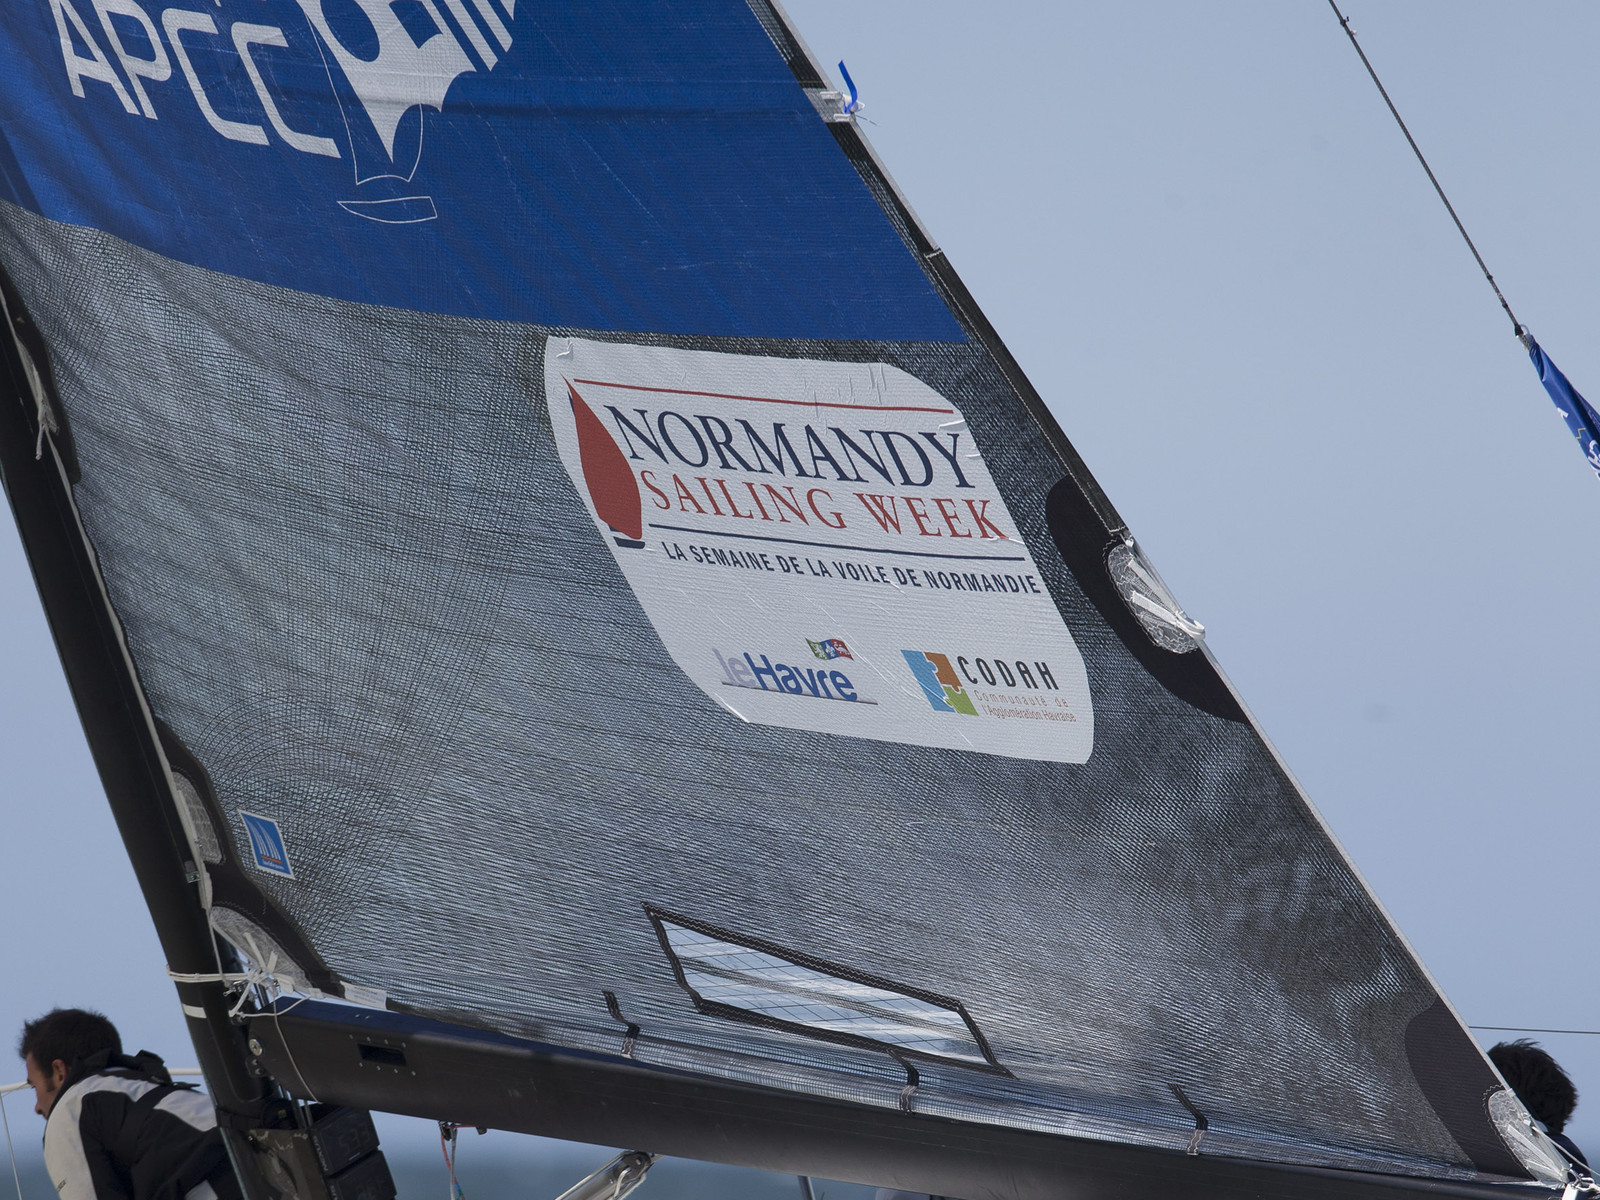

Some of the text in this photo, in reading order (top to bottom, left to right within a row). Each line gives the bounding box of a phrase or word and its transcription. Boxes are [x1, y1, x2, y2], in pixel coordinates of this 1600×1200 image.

[51, 0, 341, 158] APCC
[603, 404, 975, 488] NORMANDY
[641, 470, 1009, 539] SAILING WEEK
[661, 541, 1041, 593] LA SEMAINE DE LA VOILE DE NORMANDIE
[957, 656, 1059, 690] CODAH
